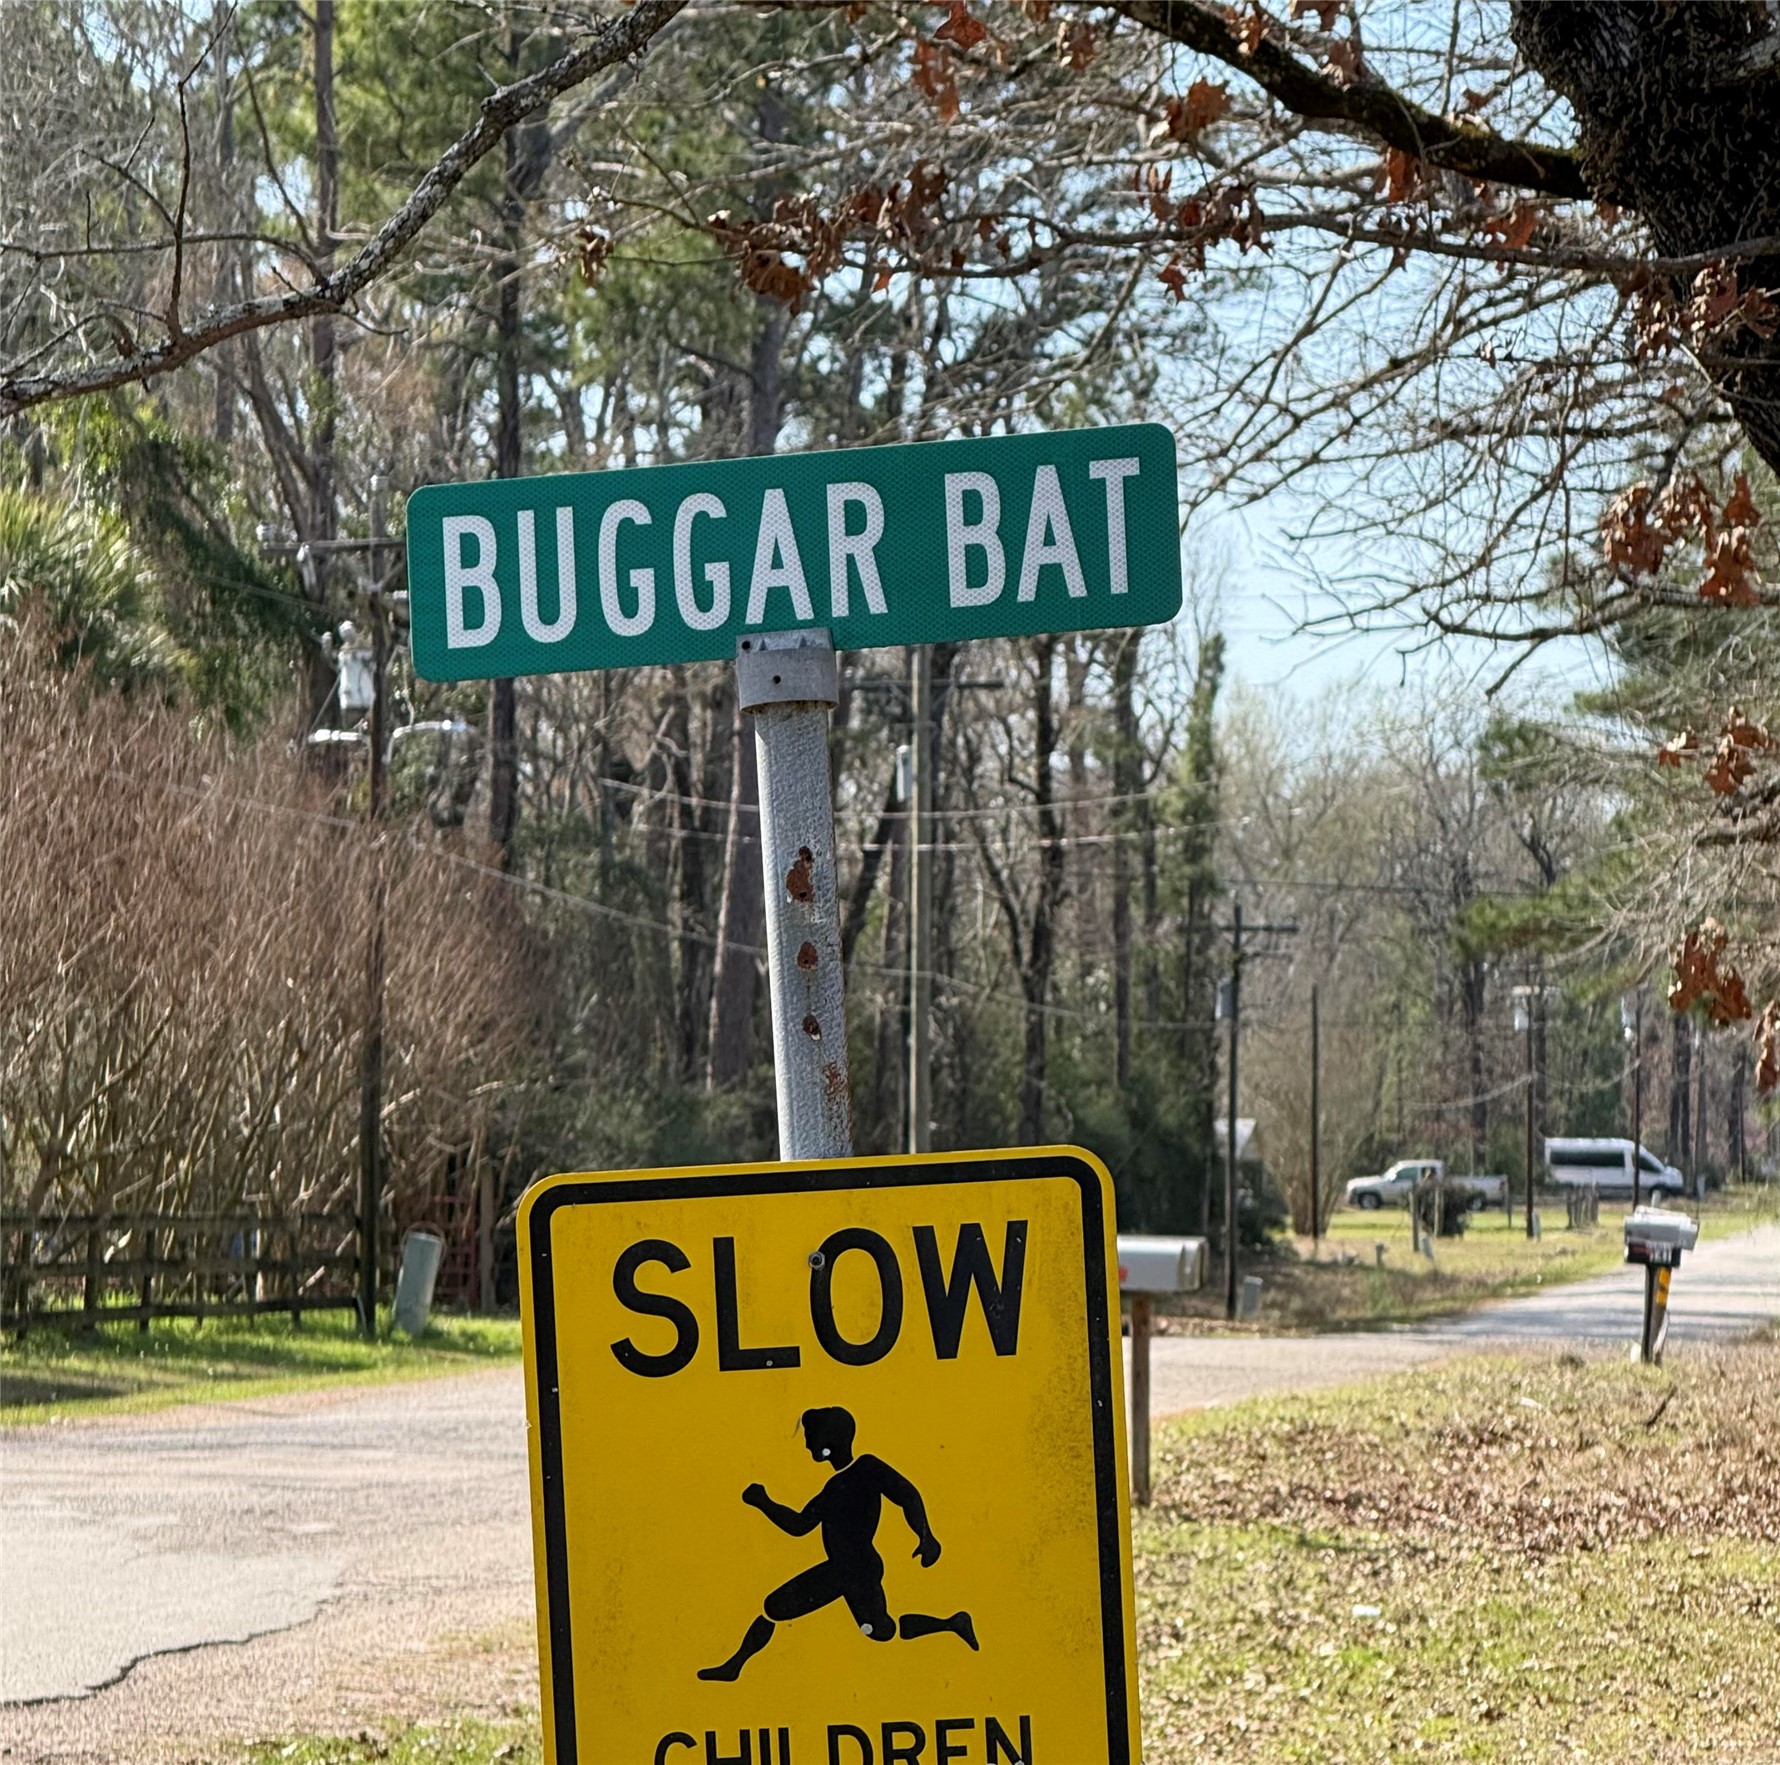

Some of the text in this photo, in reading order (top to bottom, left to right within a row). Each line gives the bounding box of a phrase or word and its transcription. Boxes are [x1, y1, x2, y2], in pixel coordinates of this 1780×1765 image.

[442, 457, 1141, 650] BUGGAR BAT
[610, 1219, 1029, 1378] SLOW
